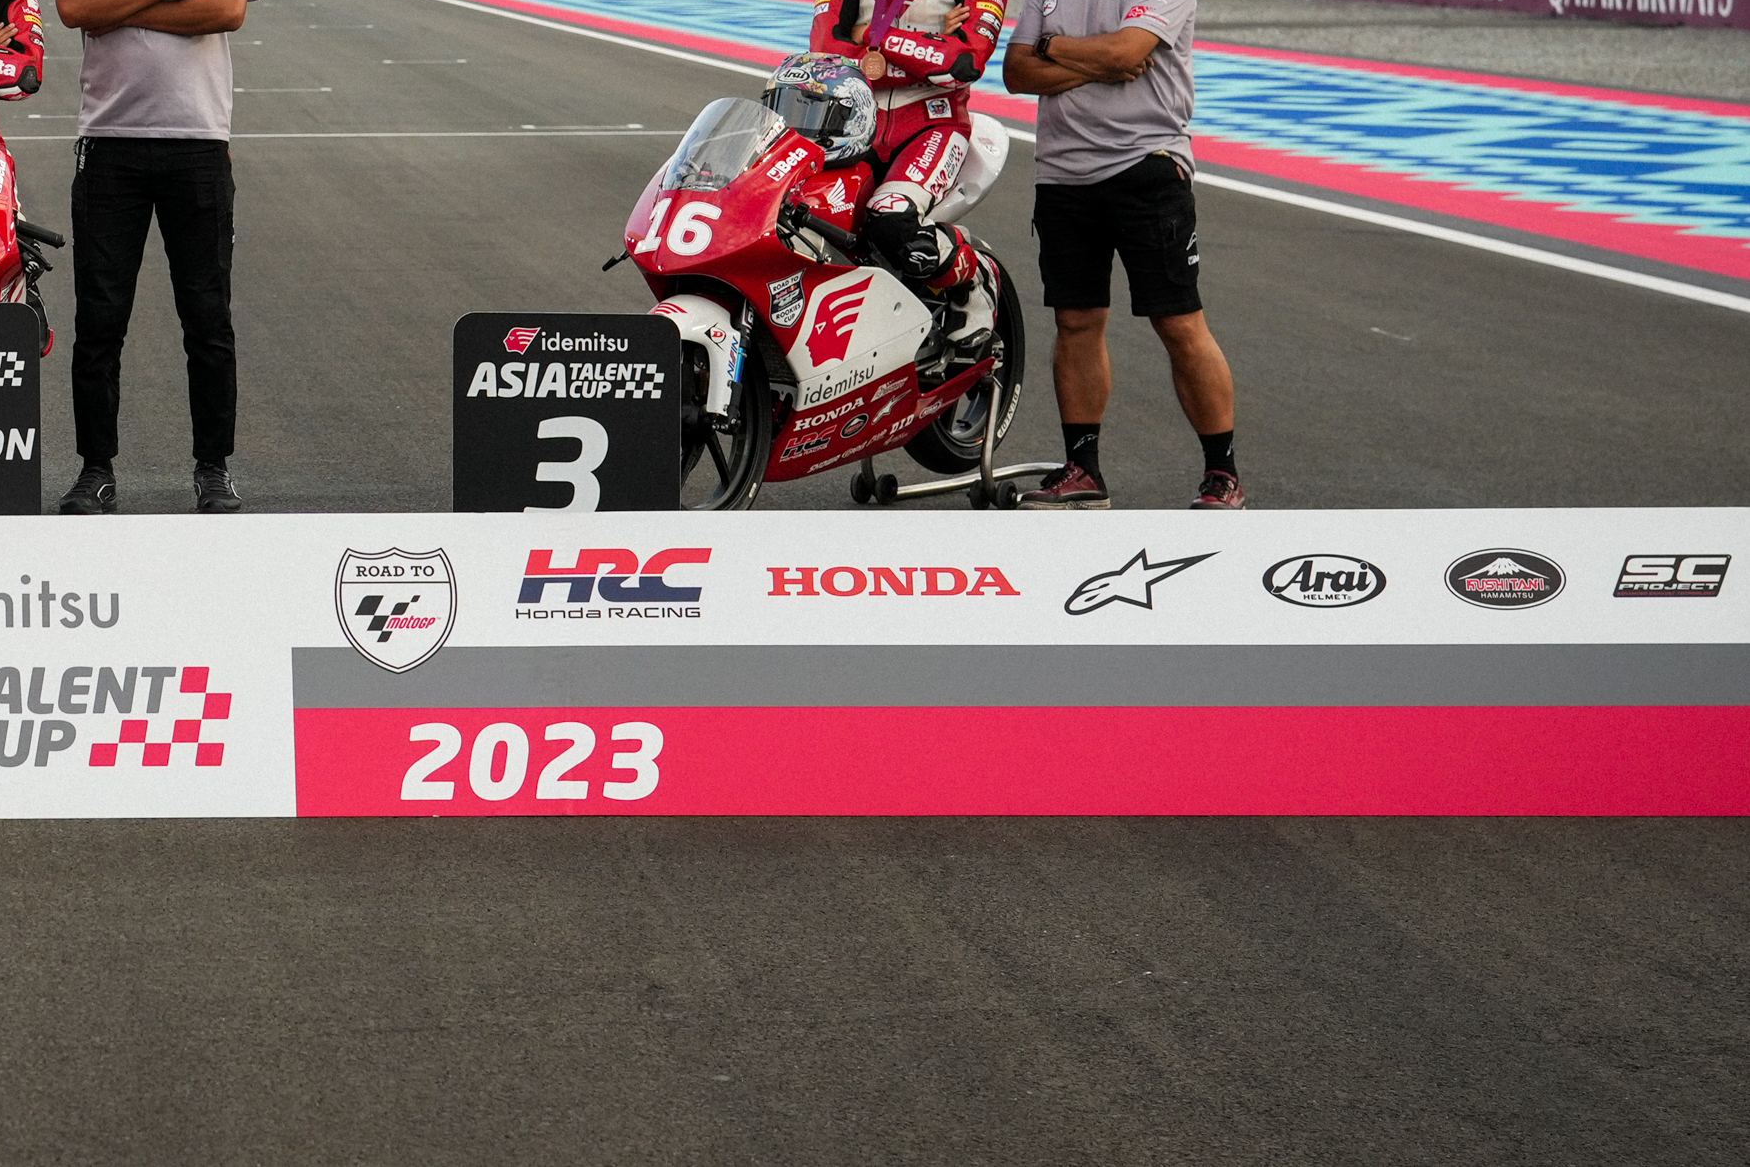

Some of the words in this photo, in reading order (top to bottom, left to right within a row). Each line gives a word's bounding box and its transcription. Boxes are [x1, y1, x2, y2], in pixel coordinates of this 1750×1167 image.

[900, 38, 945, 65] Beta
[782, 69, 807, 80] Arai
[776, 147, 809, 173] Beta
[916, 131, 943, 170] idemitsu
[831, 202, 855, 215] HONDA
[634, 197, 722, 256] 16
[783, 313, 795, 323] CUP
[541, 332, 629, 352] idemitsu
[467, 362, 567, 398] ASIA
[569, 363, 646, 381] TALENT
[569, 381, 612, 399] CUP
[804, 365, 875, 406] idemitsu
[793, 397, 864, 431] HONDA
[523, 416, 609, 513] 3
[355, 565, 405, 578] ROAD
[411, 565, 435, 577] TO
[517, 547, 713, 604] HRC
[766, 566, 1021, 598] HONDA
[1272, 559, 1372, 595] Arai
[1621, 557, 1727, 583] SC
[1465, 579, 1545, 592] KUSHITANI
[1618, 583, 1719, 591] PROJECT
[515, 607, 602, 620] Honda
[608, 606, 701, 619] RACING
[400, 721, 665, 802] 2023
